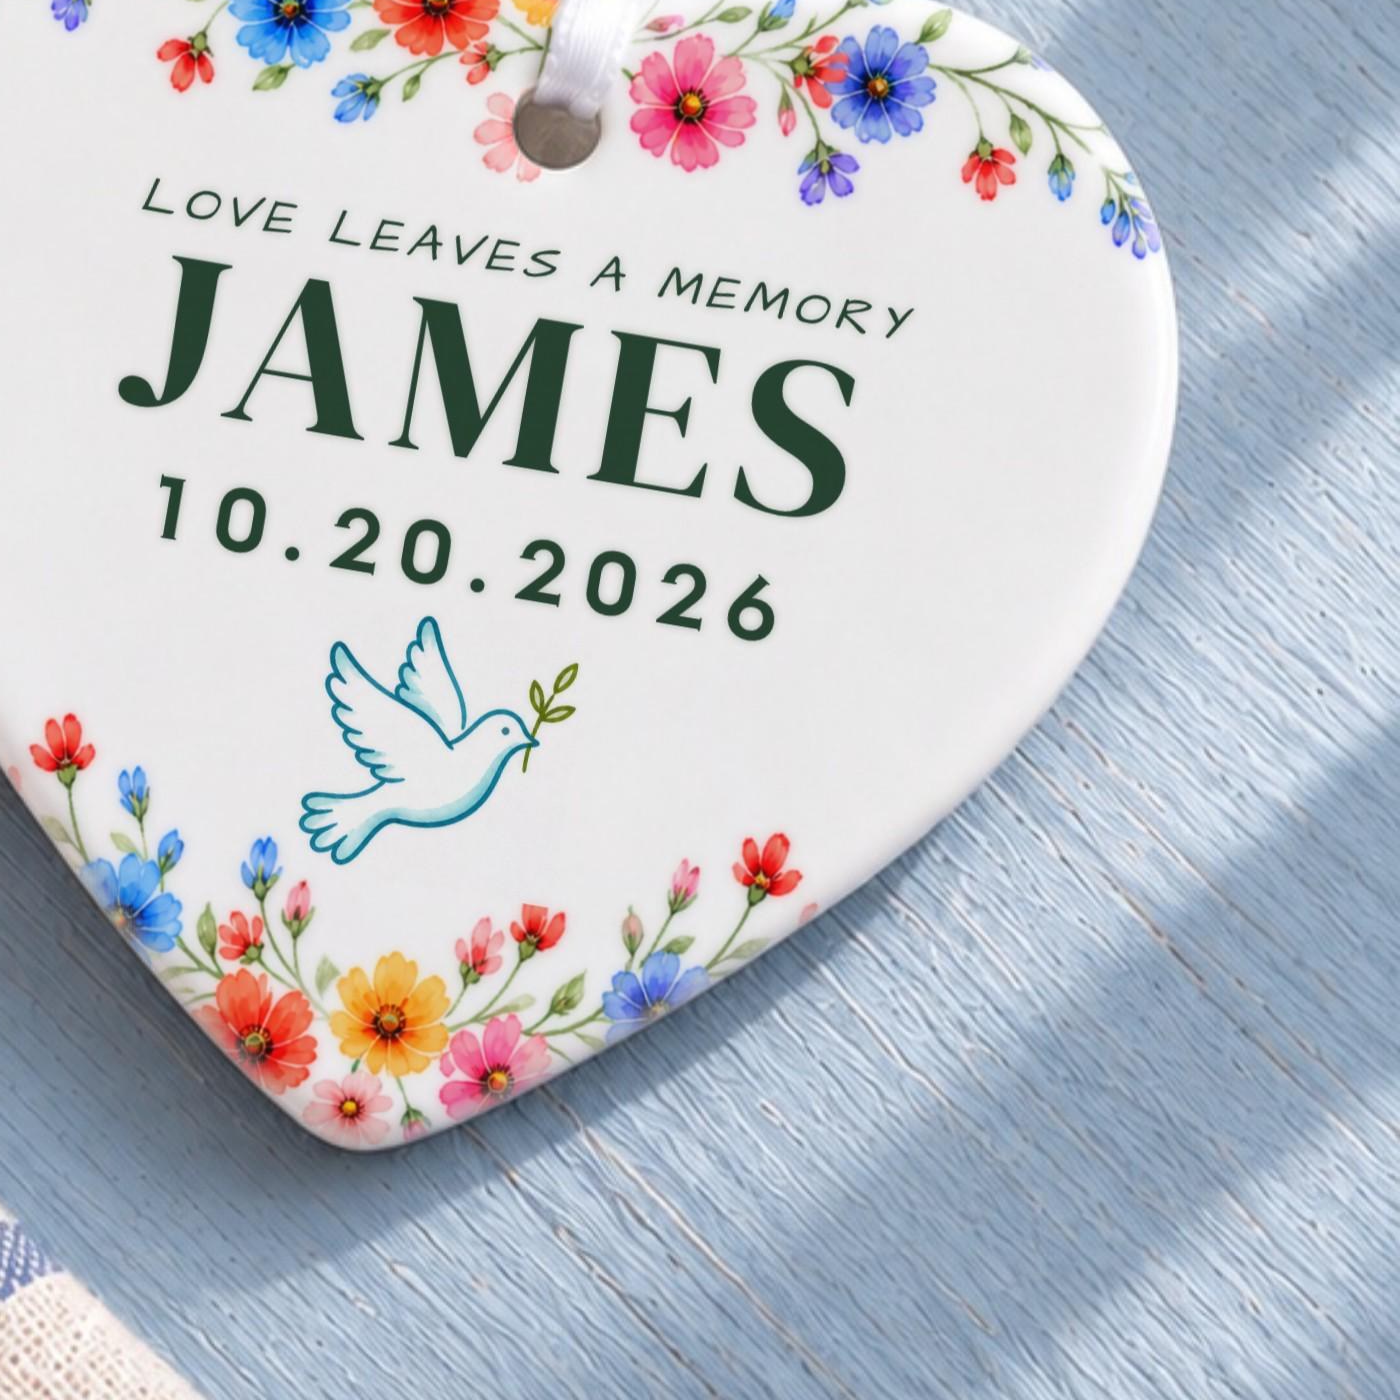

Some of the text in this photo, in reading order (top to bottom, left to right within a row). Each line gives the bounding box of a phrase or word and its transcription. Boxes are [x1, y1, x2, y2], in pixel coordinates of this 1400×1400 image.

[141, 177, 915, 339] LOVE LEAVES A MEMORY
[117, 255, 856, 518] JAMES
[159, 473, 775, 642] 10.20.2026
